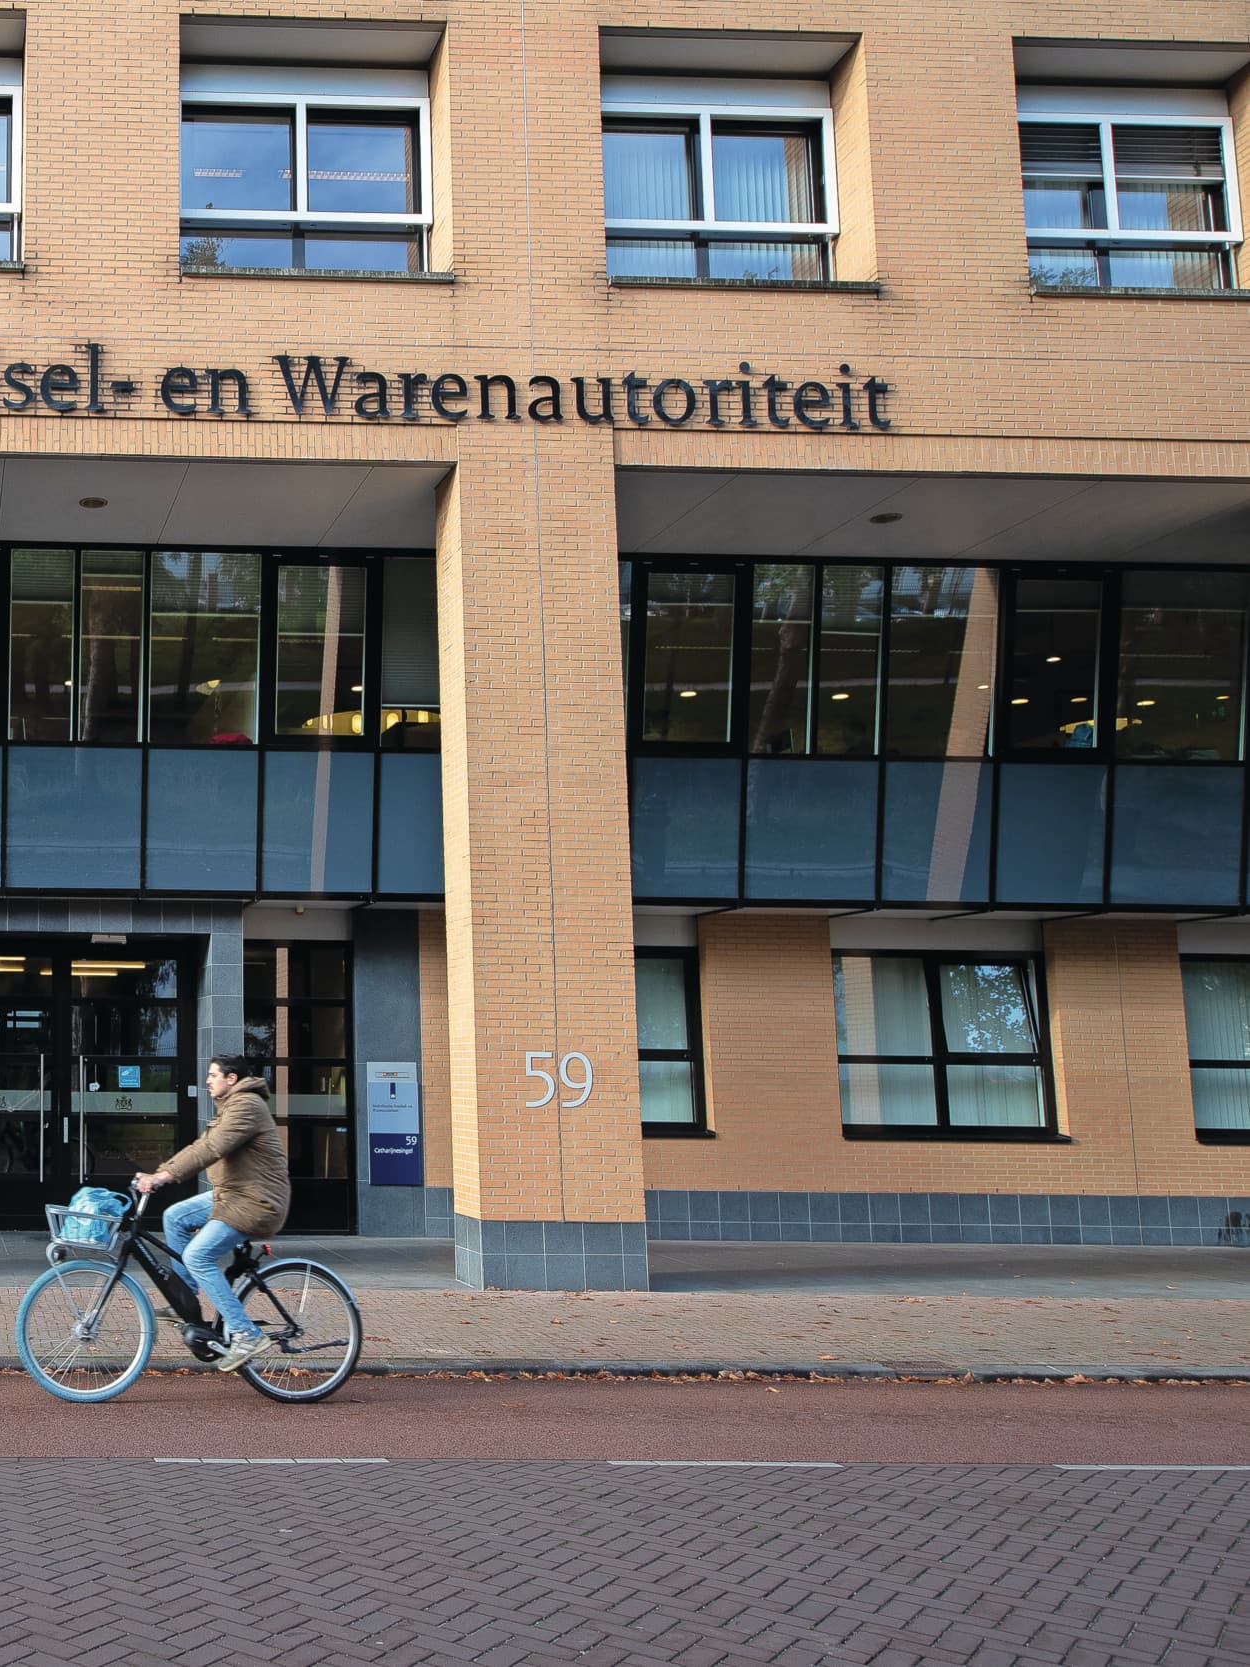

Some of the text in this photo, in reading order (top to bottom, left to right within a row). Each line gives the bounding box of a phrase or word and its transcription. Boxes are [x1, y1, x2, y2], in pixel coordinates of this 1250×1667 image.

[161, 366, 253, 416] en
[273, 353, 892, 430] Warenautoriteit
[525, 1051, 594, 1108] 59
[405, 1135, 417, 1146] 59
